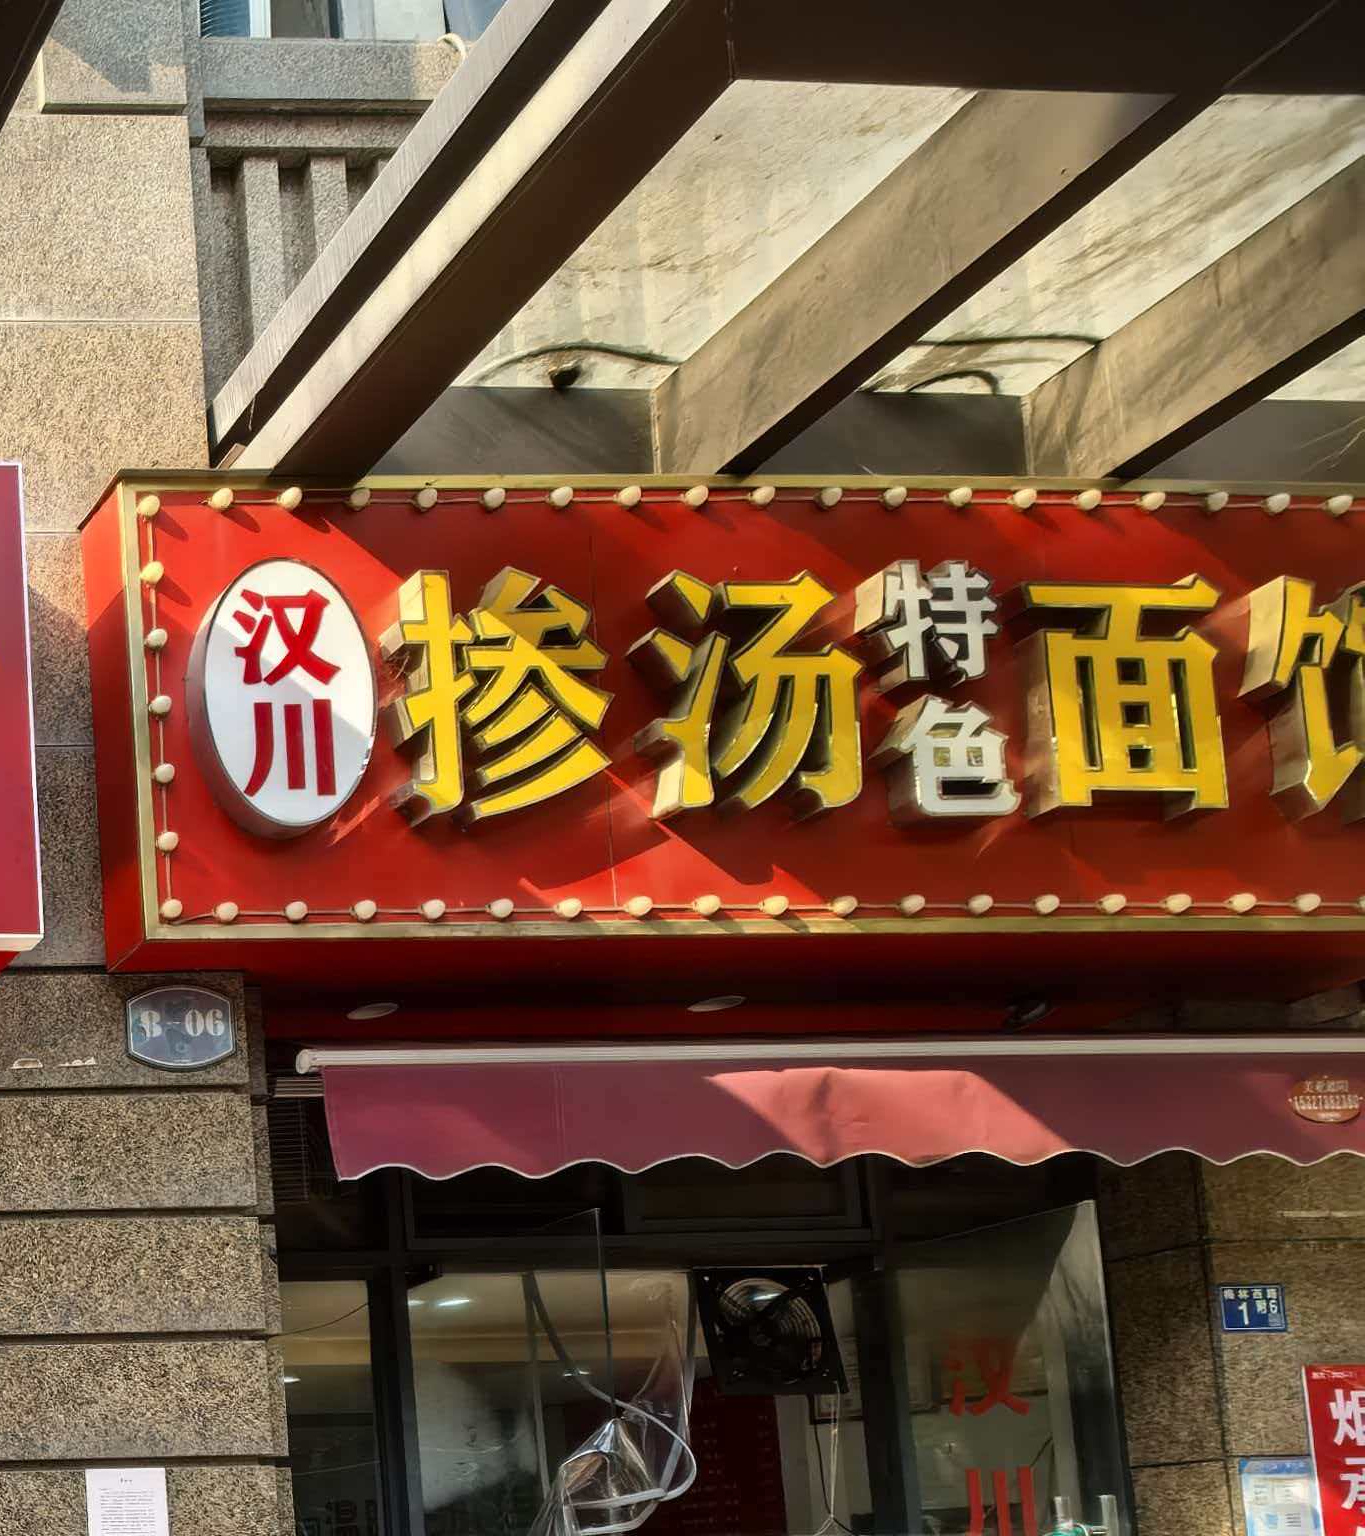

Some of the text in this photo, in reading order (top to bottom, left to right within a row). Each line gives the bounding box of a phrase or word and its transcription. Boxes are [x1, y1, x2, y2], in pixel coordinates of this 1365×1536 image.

[233, 588, 340, 801] 汉川
[389, 566, 869, 819] 掺汤
[874, 560, 1021, 818] 特色
[1237, 1301, 1250, 1325] 1
